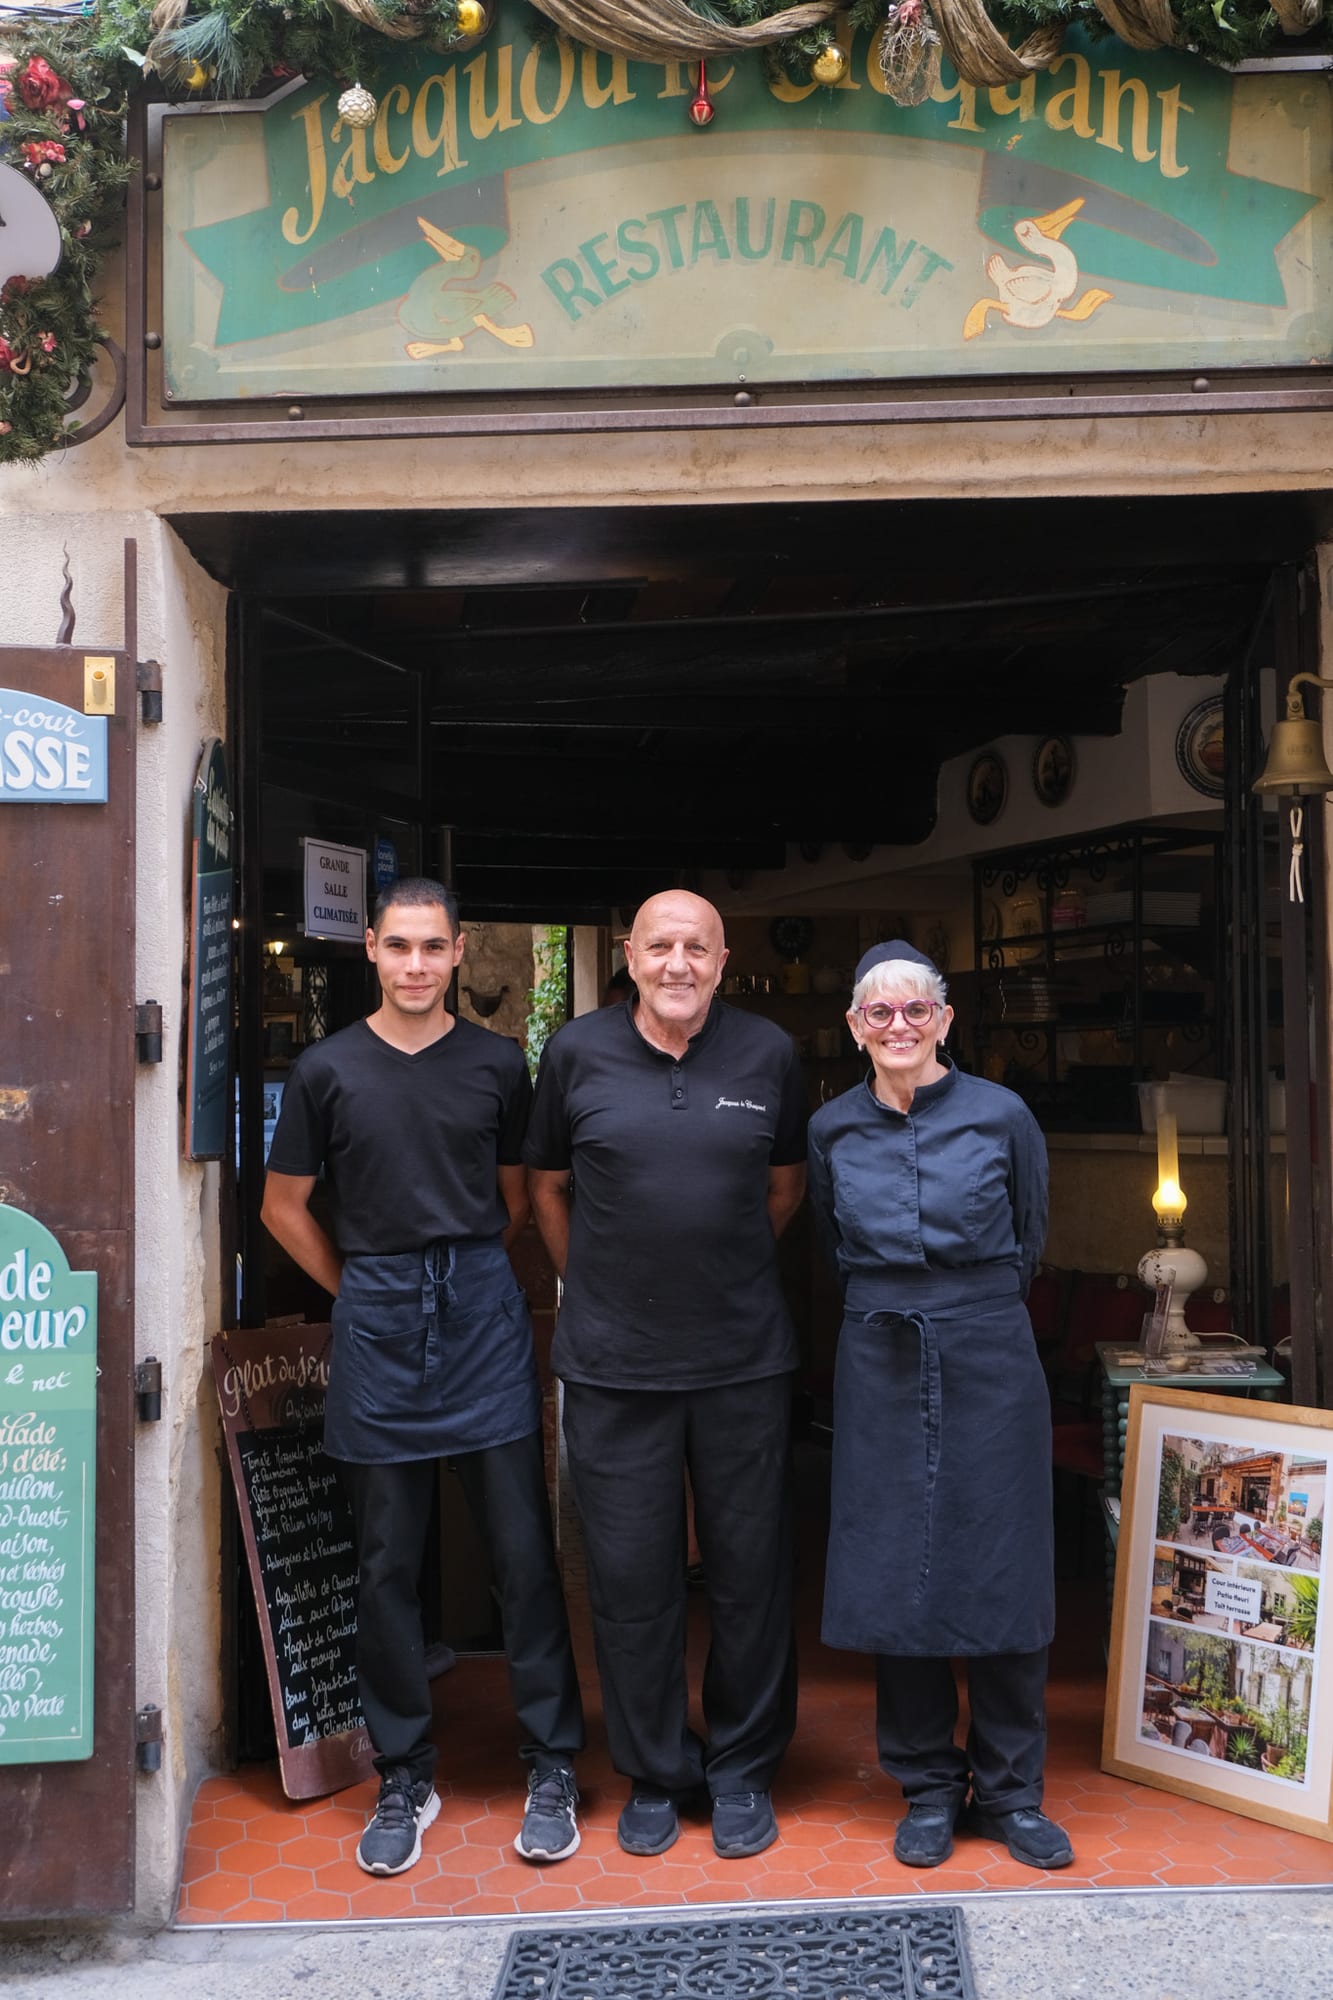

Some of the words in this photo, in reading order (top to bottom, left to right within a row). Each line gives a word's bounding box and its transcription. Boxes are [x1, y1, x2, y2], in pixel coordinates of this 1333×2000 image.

[541, 196, 954, 322] RESTAURANT
[0, 707, 85, 738] -cour
[0, 730, 92, 790] SSE
[319, 856, 350, 874] GRANDE
[323, 882, 348, 899] SALLE
[313, 905, 359, 925] CLIMATISÉE
[1, 1247, 54, 1302] de
[0, 1304, 88, 1350] eur
[279, 1355, 297, 1381] du
[32, 1371, 71, 1392] net
[0, 1503, 70, 1530] d-Ouest,
[0, 1532, 55, 1560] aison,
[1211, 1577, 1226, 1587] Cour
[1226, 1580, 1257, 1593] intérieure
[1216, 1590, 1233, 1600] Patio
[1226, 1604, 1251, 1616] terrasse
[0, 1693, 21, 1719] de
